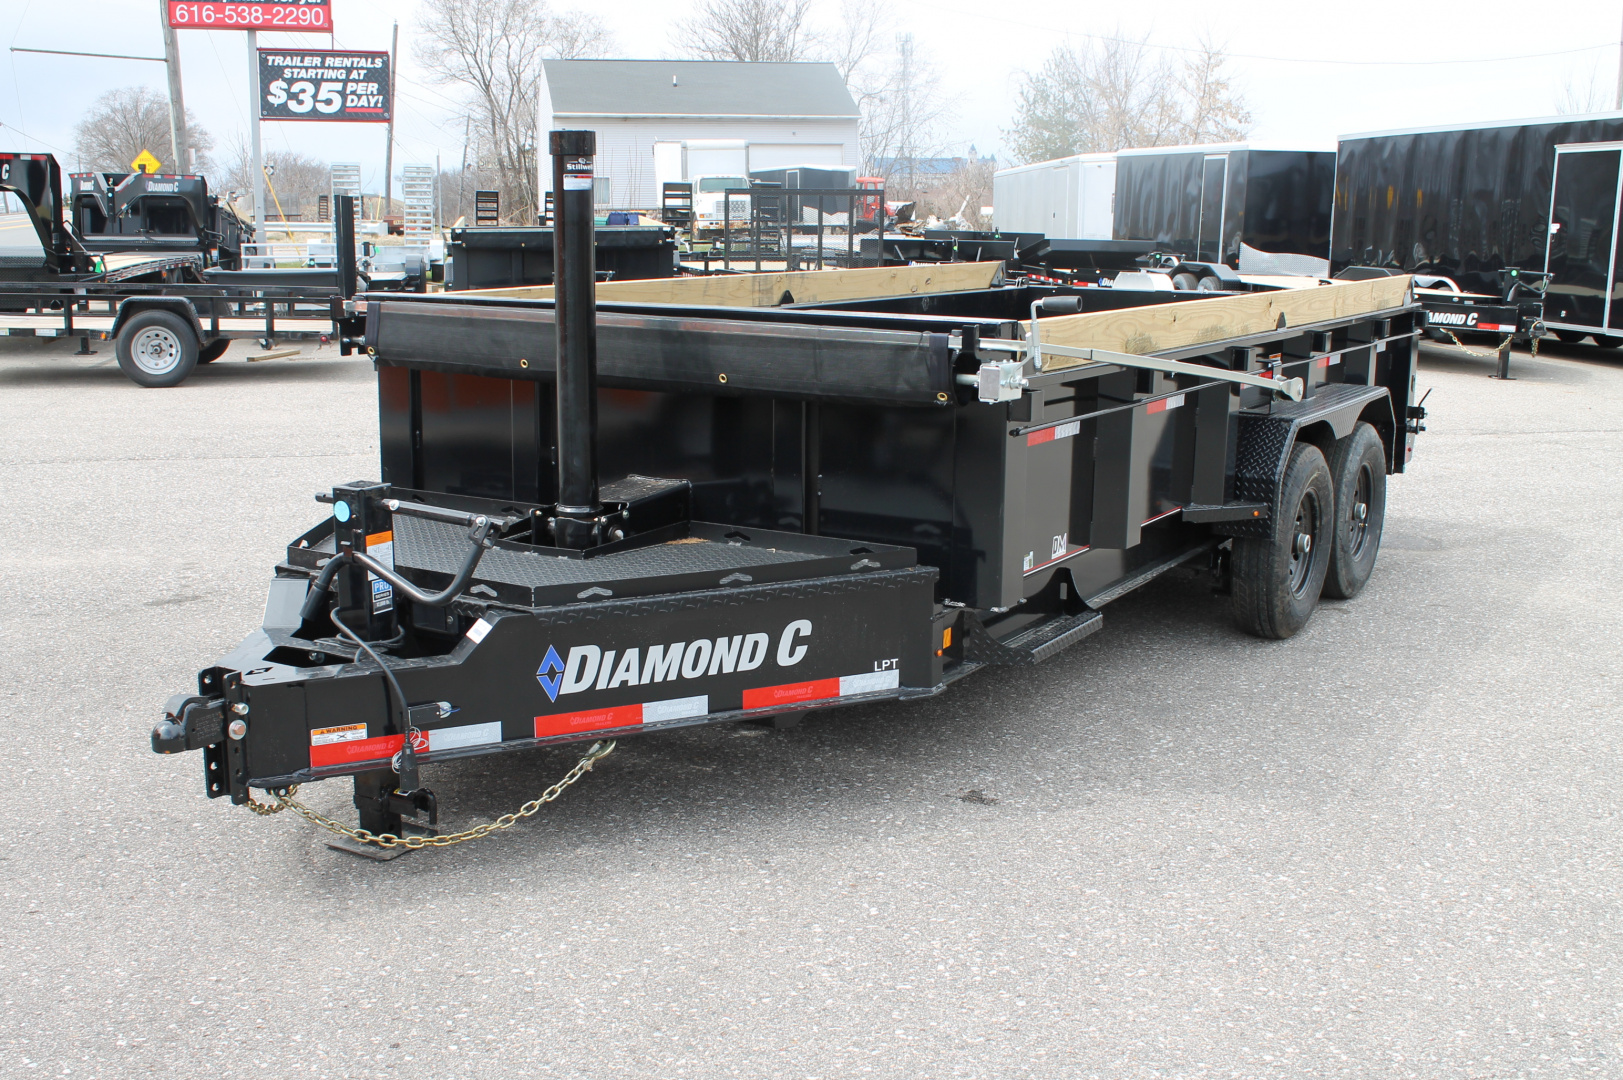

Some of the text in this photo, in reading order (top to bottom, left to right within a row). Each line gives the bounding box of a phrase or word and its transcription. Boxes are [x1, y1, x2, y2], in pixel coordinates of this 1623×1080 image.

[175, 4, 324, 25] 616-538-2290
[266, 55, 383, 68] TRAILER RENTALS
[283, 68, 367, 80] STARTING AT
[266, 78, 379, 114] $35 PER
[345, 95, 384, 108] DAY!
[1, 163, 10, 180] C
[148, 181, 179, 192] DIAMOND C
[1467, 312, 1479, 326] C
[559, 619, 813, 695] DIAMOND C
[874, 658, 899, 672] LPT
[777, 686, 813, 699] DIAMOND C
[662, 701, 700, 714] DIAMOND C
[573, 712, 614, 725] DIAMOND C
[325, 725, 358, 734] WARNING
[351, 740, 395, 754] DIAMOND C
